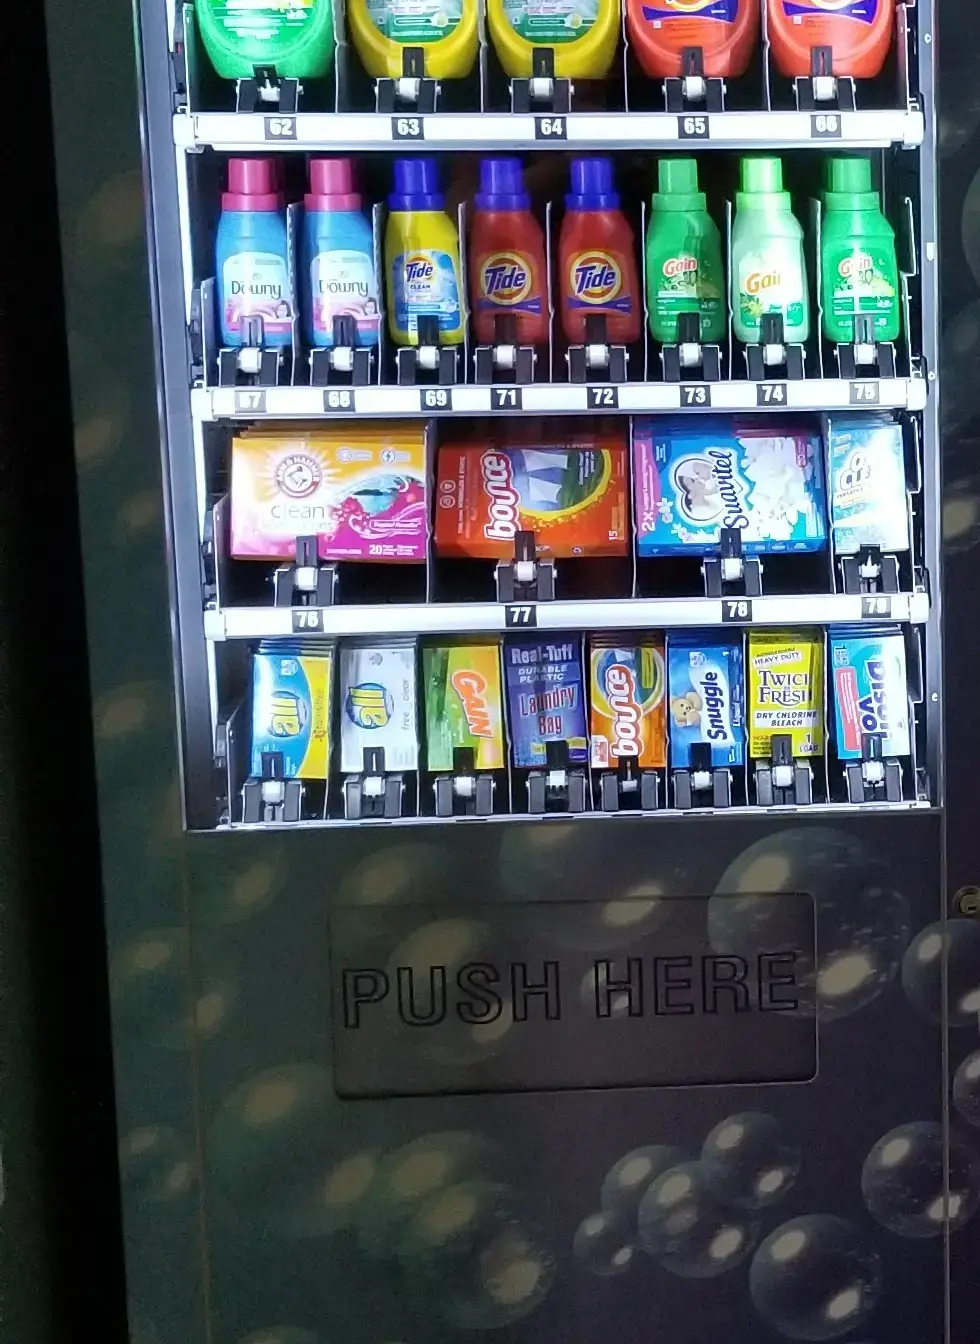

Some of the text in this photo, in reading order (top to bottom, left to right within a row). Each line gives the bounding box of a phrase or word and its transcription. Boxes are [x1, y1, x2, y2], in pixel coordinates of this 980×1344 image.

[270, 119, 293, 136] 62
[397, 119, 420, 135] 63
[541, 119, 563, 135] 64
[683, 118, 706, 134] 65
[406, 262, 433, 283] Tide
[664, 258, 698, 275] Gain
[483, 272, 527, 295] Tide
[574, 265, 617, 290] Tide
[231, 281, 281, 299] Downy
[319, 279, 369, 297] Downy
[328, 390, 351, 407] 68
[425, 389, 447, 406] 69
[496, 389, 517, 405] 71
[592, 388, 614, 405] 72
[684, 387, 706, 404] 73
[762, 386, 784, 402] 74
[484, 452, 521, 541] bounce
[708, 450, 749, 530] Suavitel
[271, 505, 325, 519] clean
[369, 544, 382, 555] 20
[727, 601, 749, 617] 78
[866, 597, 887, 614] 79
[509, 607, 532, 623] 77
[520, 684, 578, 716] Laundry
[700, 672, 728, 741] Snuggle
[608, 668, 640, 757] bounce
[538, 716, 563, 736] Bag
[806, 733, 812, 743] 1
[342, 952, 800, 1029] PUSH HERE
